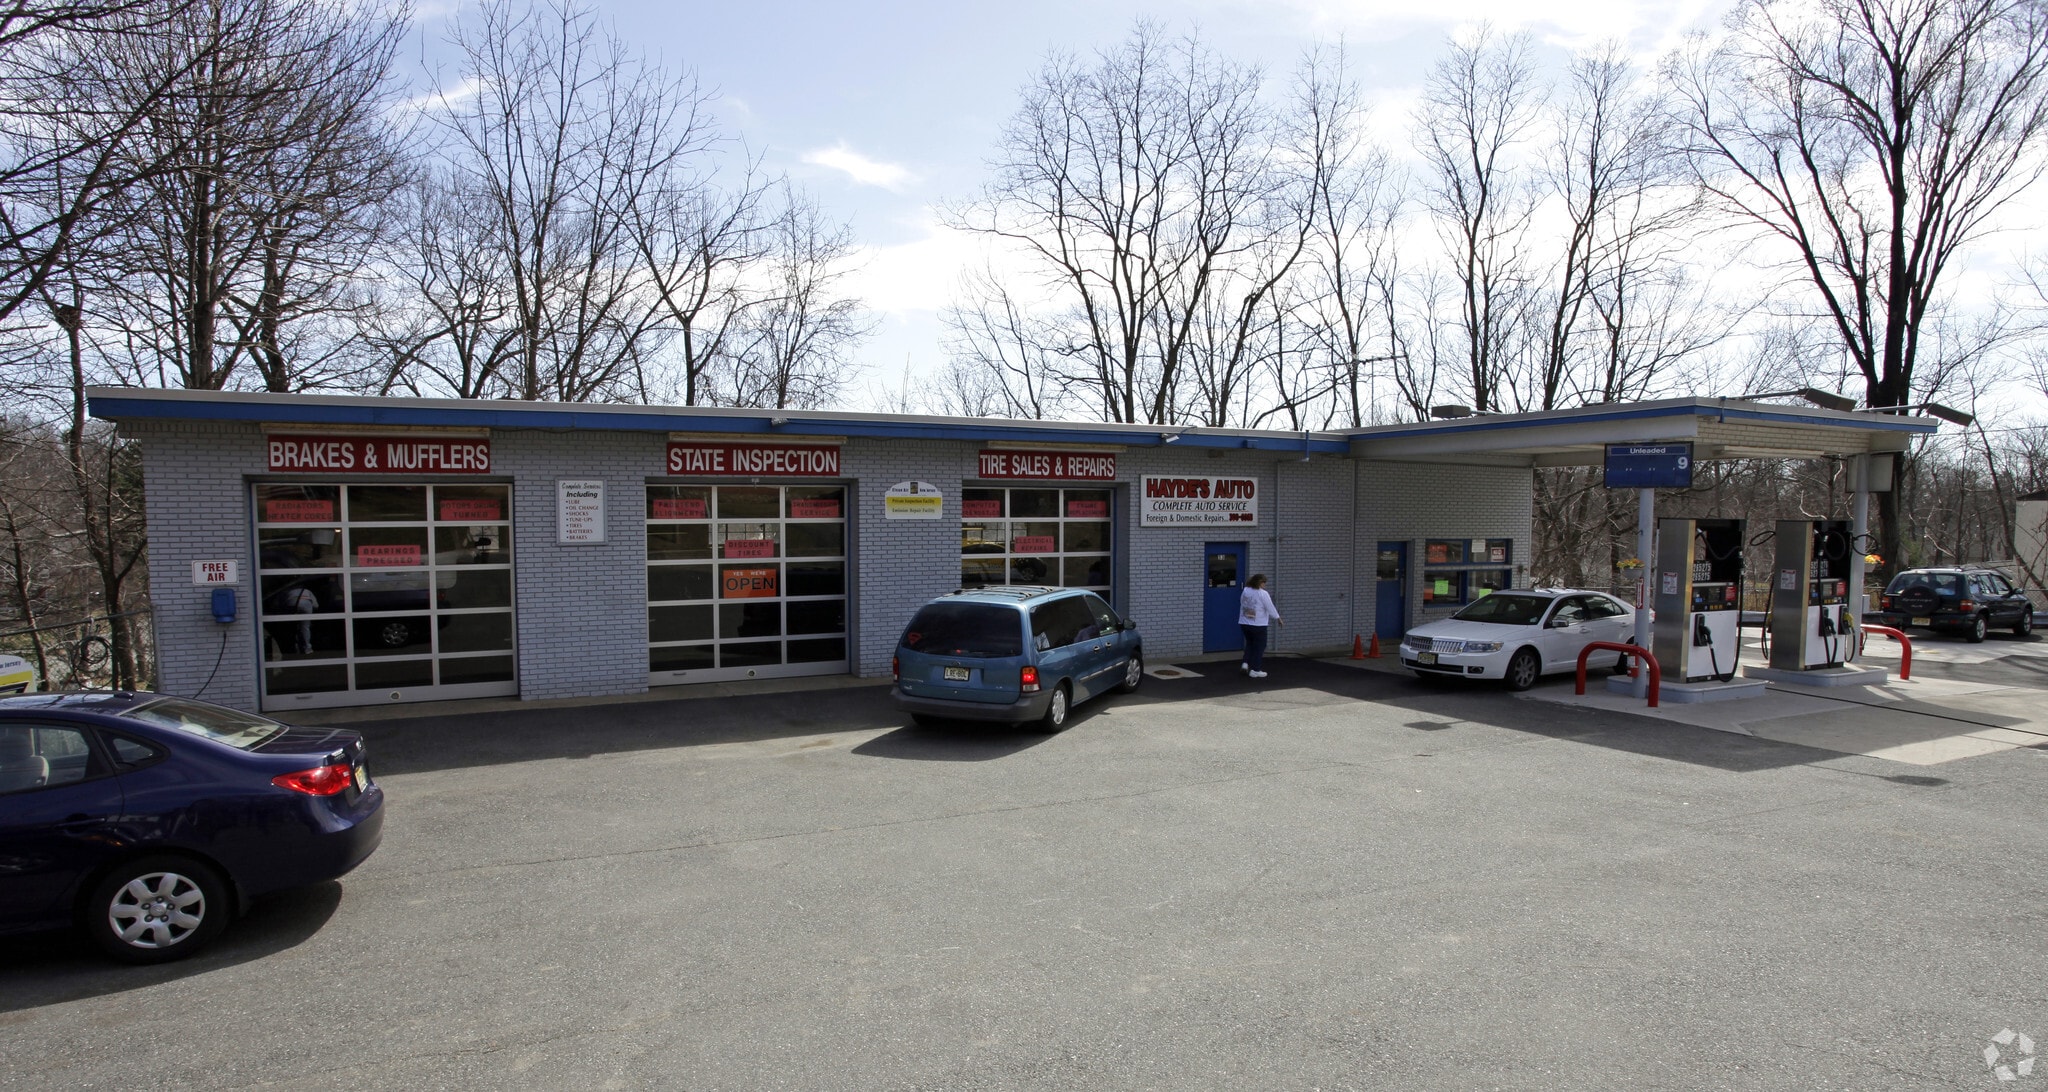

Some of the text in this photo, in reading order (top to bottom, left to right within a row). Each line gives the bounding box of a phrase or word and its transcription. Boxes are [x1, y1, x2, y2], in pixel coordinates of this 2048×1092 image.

[270, 442, 488, 470] BRAKES & MUFFLERS
[670, 448, 837, 473] STATE INSPECTION
[980, 454, 1115, 477] TIRE SALES & REPAIRS
[1677, 456, 1688, 470] 9
[1146, 478, 1255, 499] HAYDE'S AUTO
[275, 502, 324, 510] RADIATORS
[1152, 501, 1248, 511] COMPLETE AUTO SERVICE
[453, 511, 489, 519] TURNED
[1146, 514, 1168, 524] Foreign
[363, 547, 415, 555] BEARINGS
[737, 549, 762, 557] TIRES
[366, 557, 413, 565] PRESSED
[202, 563, 228, 572] FREE
[207, 572, 226, 582] AIR
[726, 577, 775, 590] OPEN
